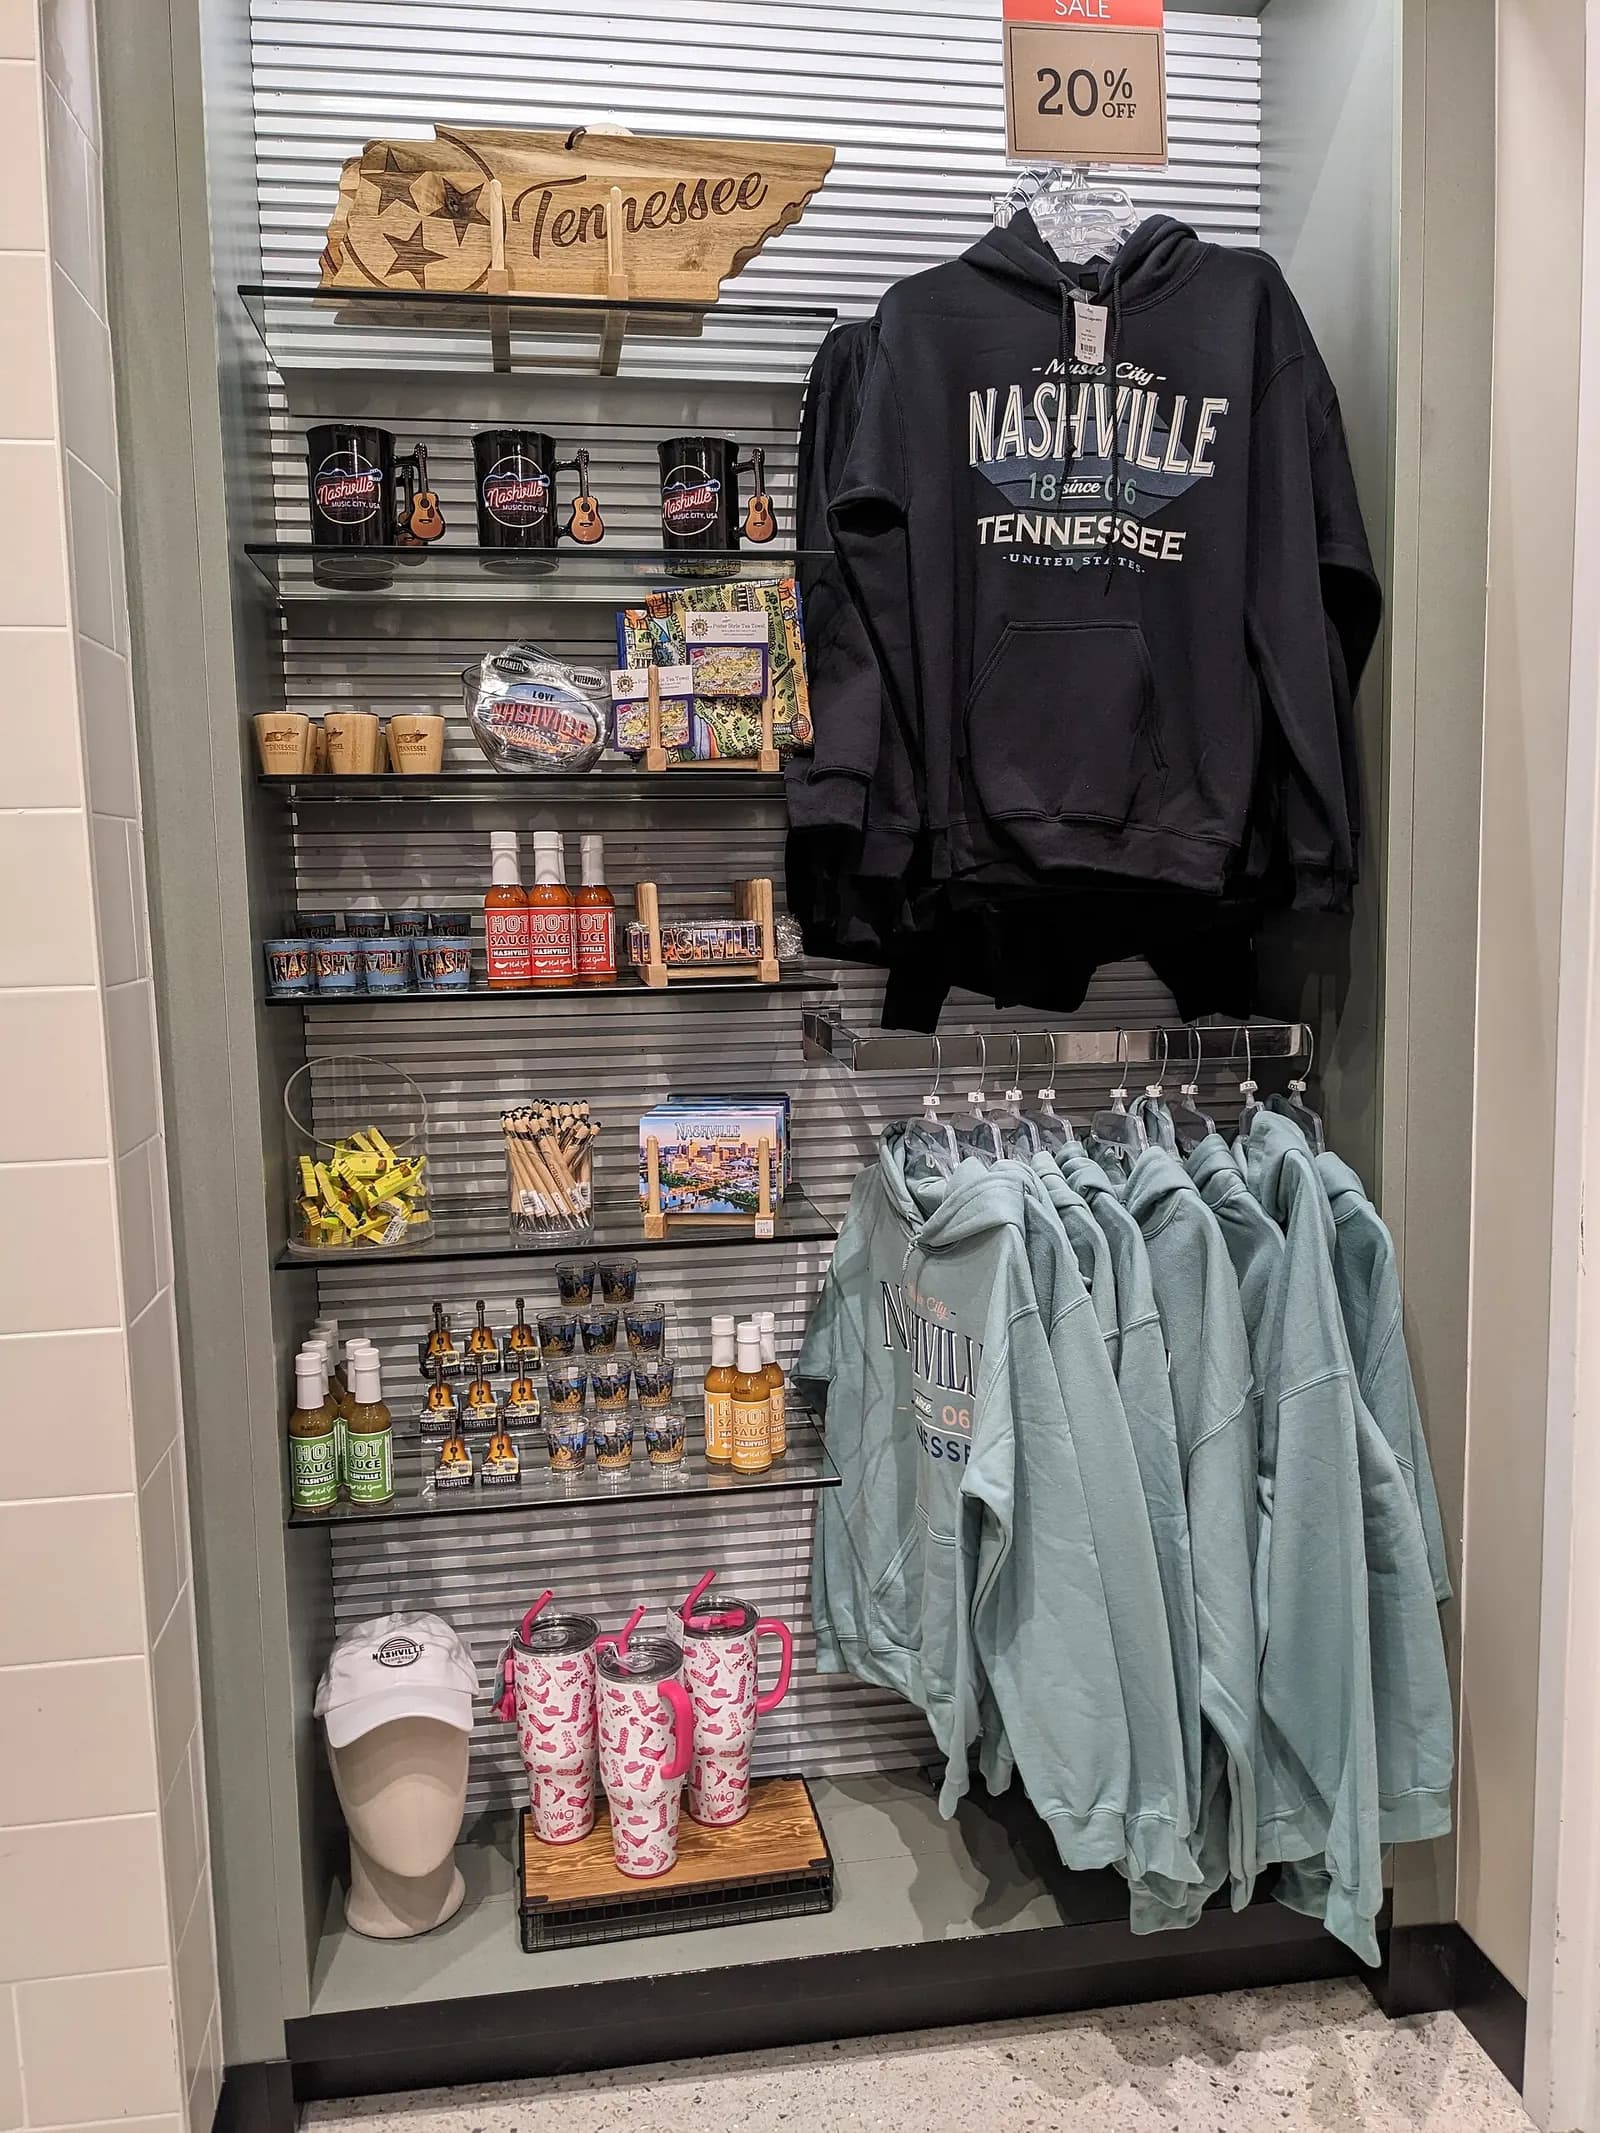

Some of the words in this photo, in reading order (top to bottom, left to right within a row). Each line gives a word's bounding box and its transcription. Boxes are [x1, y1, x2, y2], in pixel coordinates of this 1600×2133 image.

[1055, 0, 1111, 19] SALE
[1036, 67, 1133, 117] 20%
[1102, 103, 1137, 119] OFF
[512, 172, 769, 260] Tennessee
[968, 382, 1230, 478] NASHVILLE
[317, 476, 375, 505] Nashville
[487, 481, 544, 508] Nashville
[1029, 472, 1056, 501] 18
[1061, 480, 1101, 496] since
[663, 488, 712, 518] Nashville
[977, 513, 1187, 562] TENNESSEE
[532, 690, 555, 702] LOVE
[489, 915, 529, 934] HOT
[531, 914, 569, 933] HOT
[578, 913, 606, 931] OT
[490, 935, 529, 946] SAUCE
[531, 934, 570, 944] SAUCE
[942, 1405, 970, 1429] 06
[349, 1440, 382, 1458] OT
[350, 1459, 381, 1469] AUCE
[372, 1644, 425, 1661] NASHVILLE
[544, 1809, 575, 1821] swig
